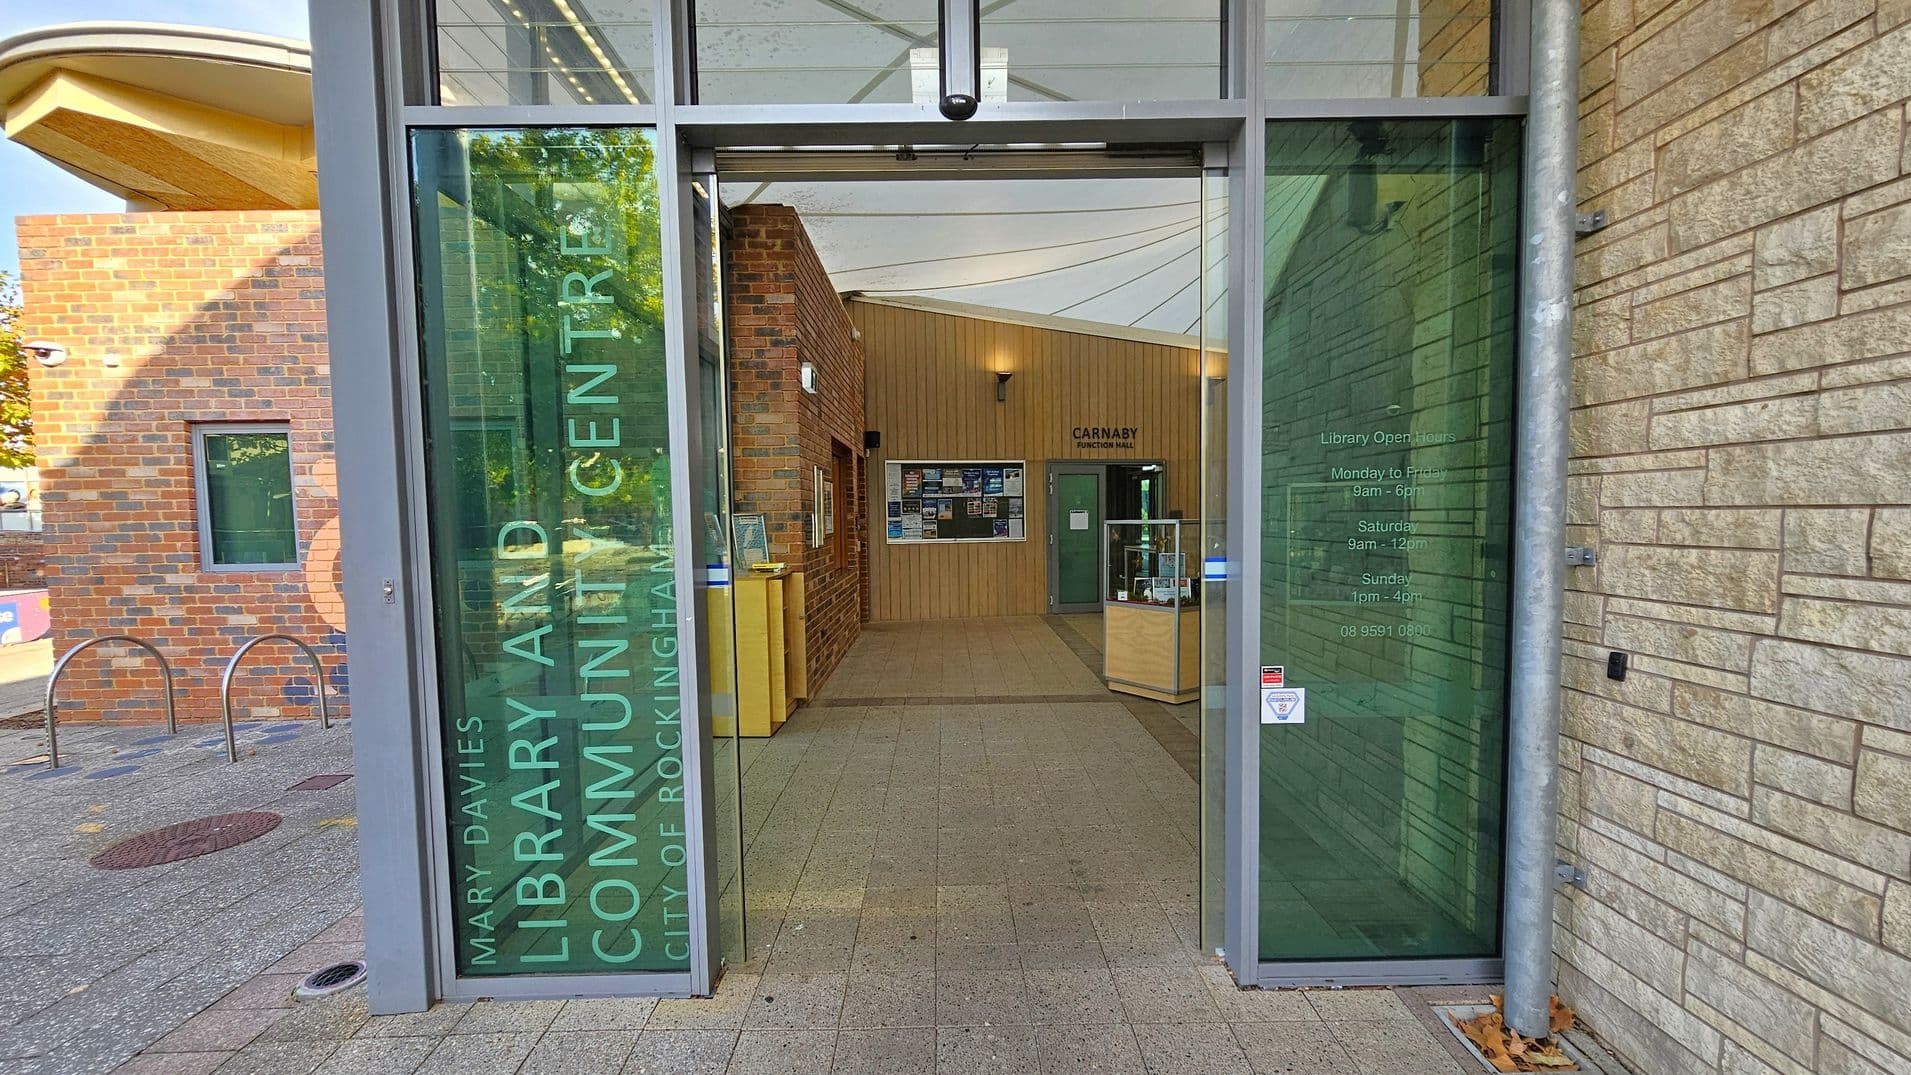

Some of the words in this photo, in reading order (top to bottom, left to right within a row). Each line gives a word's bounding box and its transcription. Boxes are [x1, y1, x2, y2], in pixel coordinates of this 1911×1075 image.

[561, 226, 622, 496] CENTRE
[1073, 427, 1138, 440] CARNABY
[1321, 432, 1370, 446] Library
[1374, 431, 1411, 446] Open
[1416, 432, 1457, 443] Hours
[1077, 441, 1114, 449] FUNCTION
[1115, 441, 1134, 449] HALL
[1331, 467, 1386, 481] Monday
[1390, 467, 1402, 479] to
[1407, 466, 1448, 481] Friday
[1353, 485, 1382, 497] 9am
[1396, 485, 1425, 499] 6pm
[1358, 520, 1419, 534] Saturday
[1348, 538, 1377, 550] 9am
[1391, 538, 1428, 551] 12pm
[1362, 573, 1413, 587] Sunday
[497, 521, 555, 666] AND
[1351, 591, 1380, 604] 1pm
[1393, 590, 1423, 604] 4pm
[1340, 625, 1357, 637] 08
[1361, 625, 1393, 637] 9591
[1398, 625, 1431, 636] 0800
[651, 543, 684, 802] ROCKINGHAM
[574, 528, 642, 963] COMMUNITY
[457, 716, 489, 846] DAVIES
[506, 697, 569, 963] LIBRARY
[661, 823, 687, 866] OF
[466, 863, 496, 966] MARY
[664, 885, 690, 961] CITY
